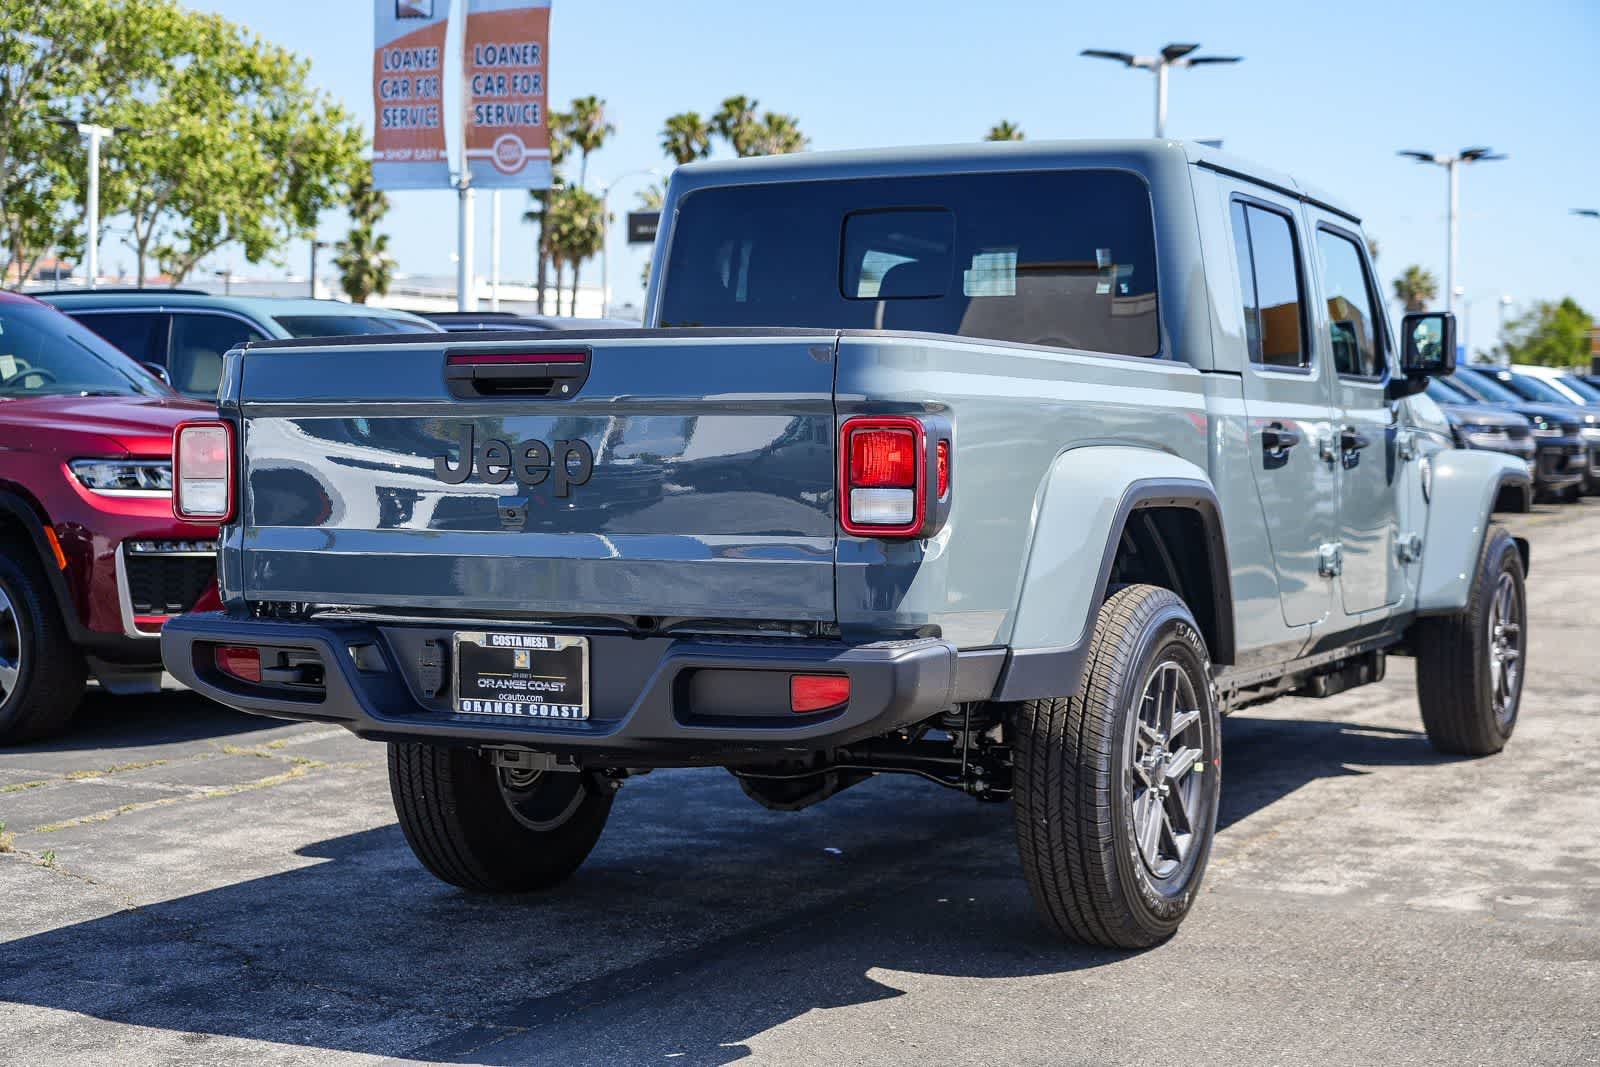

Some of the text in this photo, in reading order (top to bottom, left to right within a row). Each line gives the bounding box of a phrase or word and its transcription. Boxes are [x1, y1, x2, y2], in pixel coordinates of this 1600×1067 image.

[383, 49, 439, 70] LOANER
[475, 45, 542, 66] LOANER
[380, 77, 440, 98] CAR FOR
[472, 74, 542, 95] CAR FOR
[382, 107, 439, 128] SERVICE
[474, 104, 541, 125] SERVICE
[434, 424, 594, 498] Jeep
[492, 635, 549, 648] COSTA MESA
[477, 678, 567, 692] ORANGE COAST
[498, 693, 544, 703] ocauto.com
[462, 701, 580, 718] ORANGE COAST
